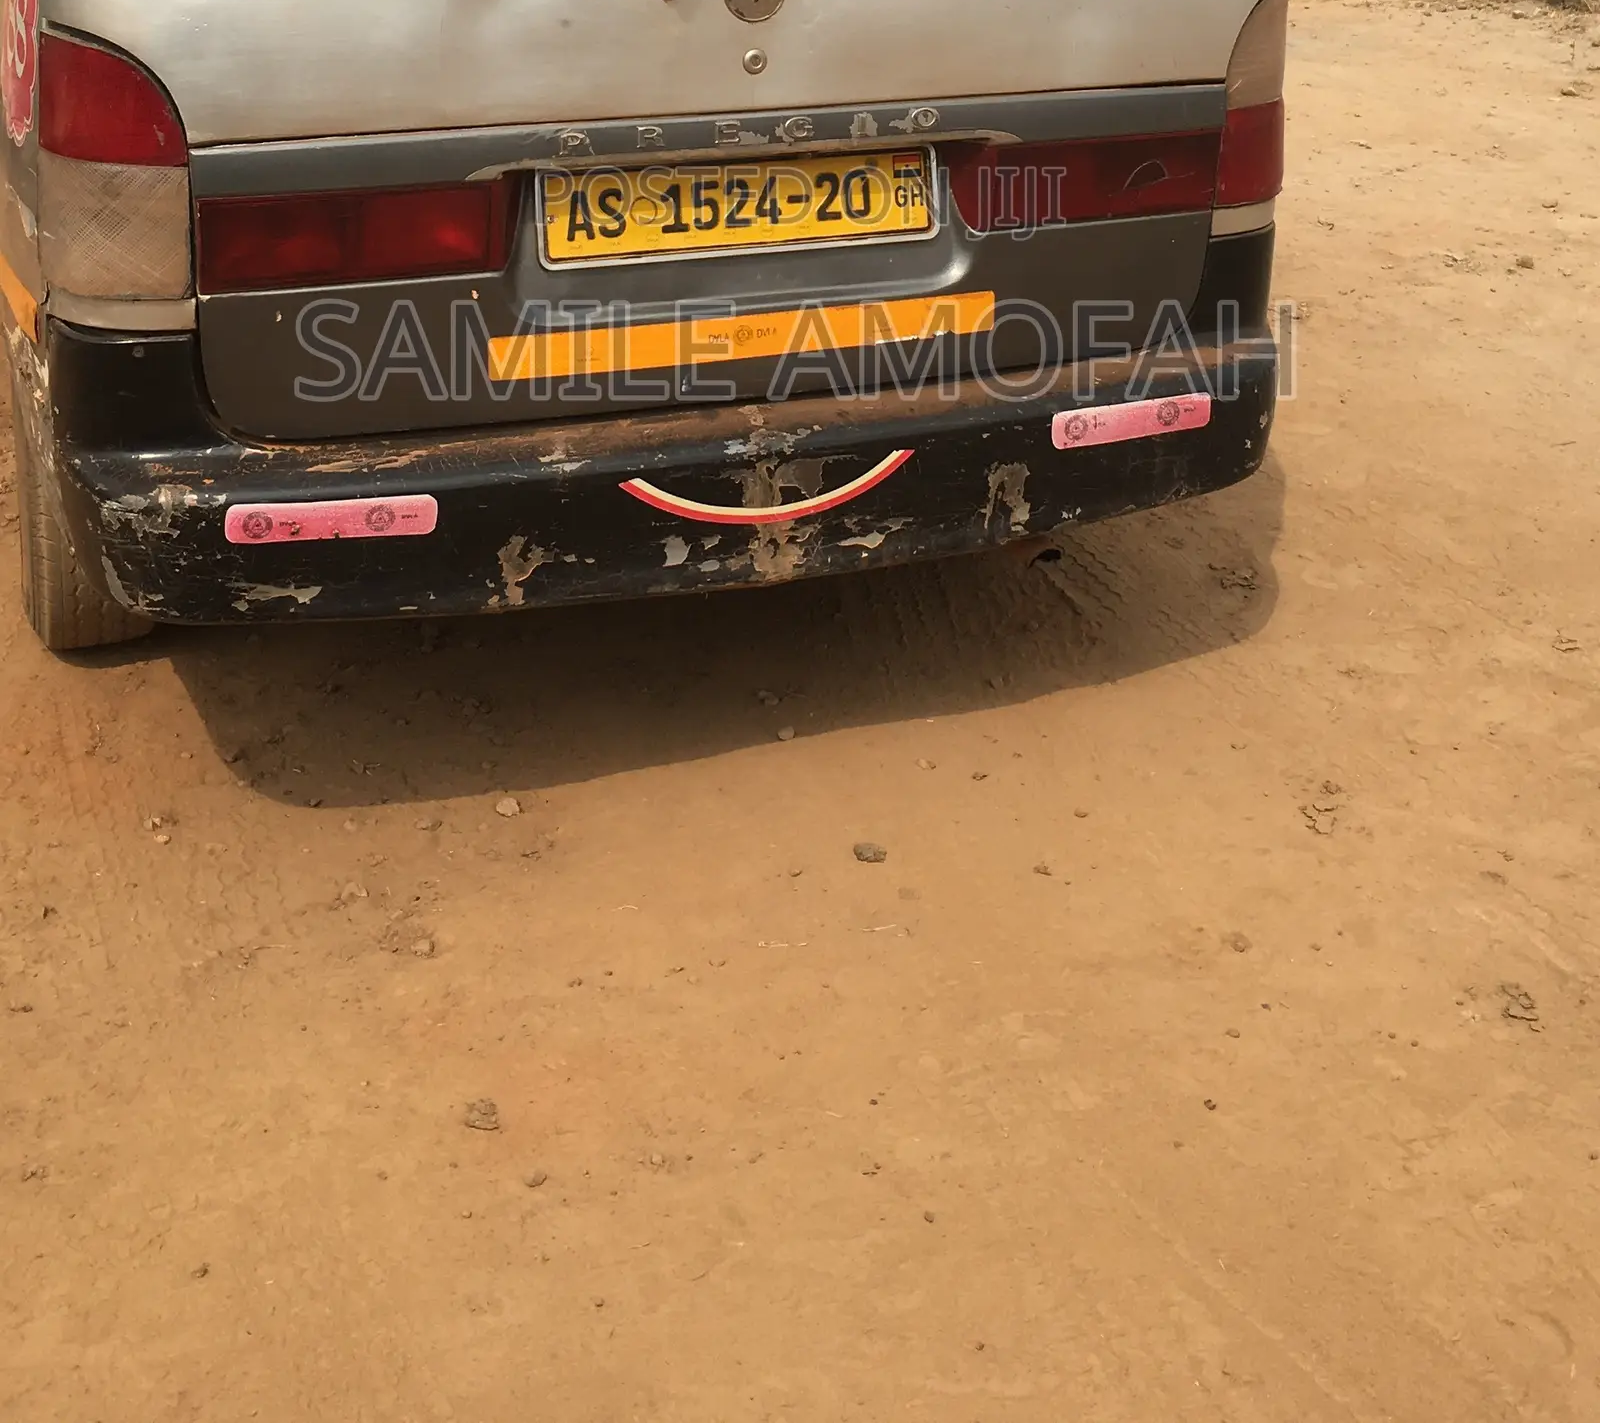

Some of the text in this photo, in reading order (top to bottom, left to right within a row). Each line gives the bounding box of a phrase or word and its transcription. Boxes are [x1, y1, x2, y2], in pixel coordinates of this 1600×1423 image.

[560, 107, 938, 156] PREGIO
[567, 169, 873, 242] AS 1524-20
[893, 185, 925, 209] GH
